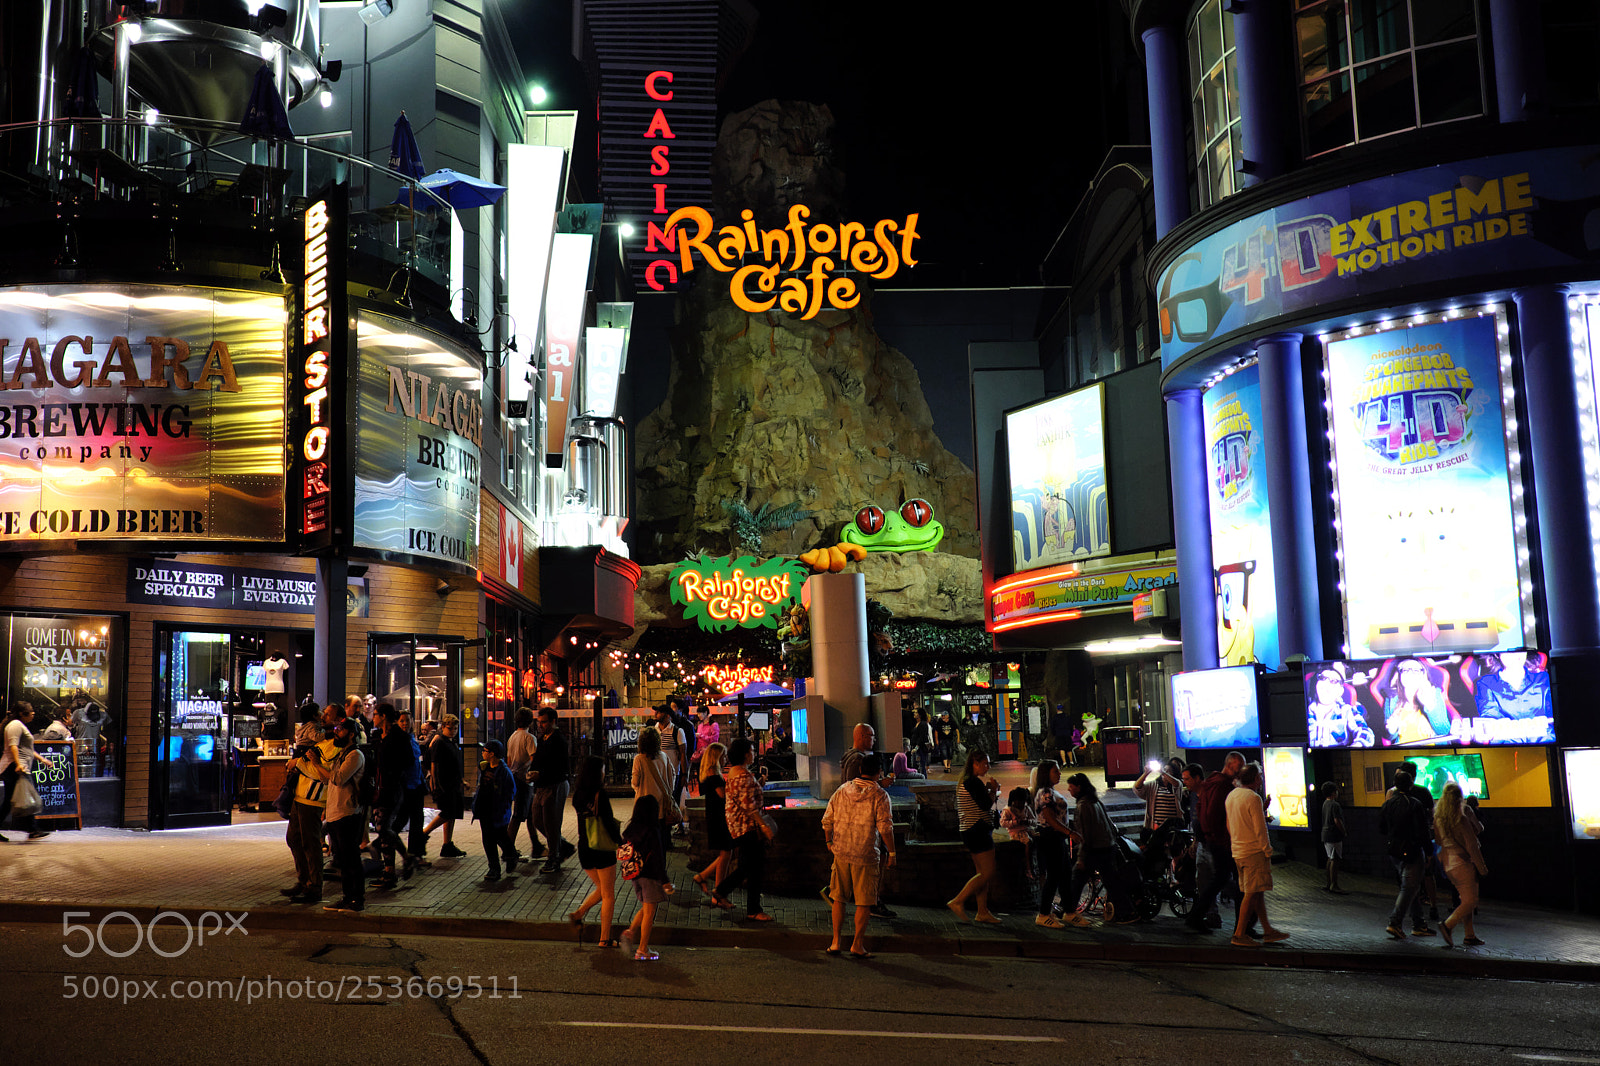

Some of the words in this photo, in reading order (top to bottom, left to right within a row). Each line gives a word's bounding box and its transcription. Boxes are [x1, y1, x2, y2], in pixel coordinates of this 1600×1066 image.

[643, 70, 678, 291] CASINO
[1329, 172, 1534, 256] EXTREME
[663, 203, 921, 279] Rainforest
[1337, 228, 1447, 277] MOTION
[1453, 212, 1529, 247] RIDE
[304, 200, 329, 346] BEER
[730, 256, 861, 321] Cafe
[1371, 343, 1443, 360] nickelodeon
[1364, 352, 1455, 381] SPONGEBOB
[1350, 367, 1475, 405] SQUAREPANTS
[304, 351, 330, 535] STORE
[1399, 440, 1439, 465] RIDE
[20, 446, 153, 462] company
[1382, 466, 1407, 475] GREAT
[1410, 464, 1434, 475] JELLY
[1436, 452, 1470, 471] RESCUE!
[29, 510, 111, 534] COLD
[116, 509, 205, 533] BEER
[409, 528, 436, 553] ICE
[136, 568, 183, 584] DAILY
[185, 571, 225, 587] BEER
[242, 576, 274, 591] LIVE
[276, 579, 316, 593] MUSIC
[679, 568, 792, 605] Rainforest
[1073, 579, 1080, 587] in
[1080, 579, 1090, 587] the
[1124, 572, 1179, 592] Arcad
[144, 583, 216, 599] SPECIALS
[243, 590, 316, 606] EVERYDAY
[1015, 591, 1035, 609] Cars
[1064, 588, 1089, 604] Mini
[1092, 586, 1119, 601] Putt
[707, 593, 766, 623] Cafe
[1038, 598, 1057, 610] Rides
[25, 627, 57, 647] COME
[60, 628, 76, 647] IN
[24, 647, 106, 666] CRAFT
[24, 666, 104, 689] BEER
[703, 663, 774, 686] Rainforest
[895, 680, 917, 689] OPEN
[176, 700, 224, 718] NIAGARA
[608, 729, 640, 747] NIAG
[32, 770, 47, 783] TO
[49, 769, 65, 782] GO
